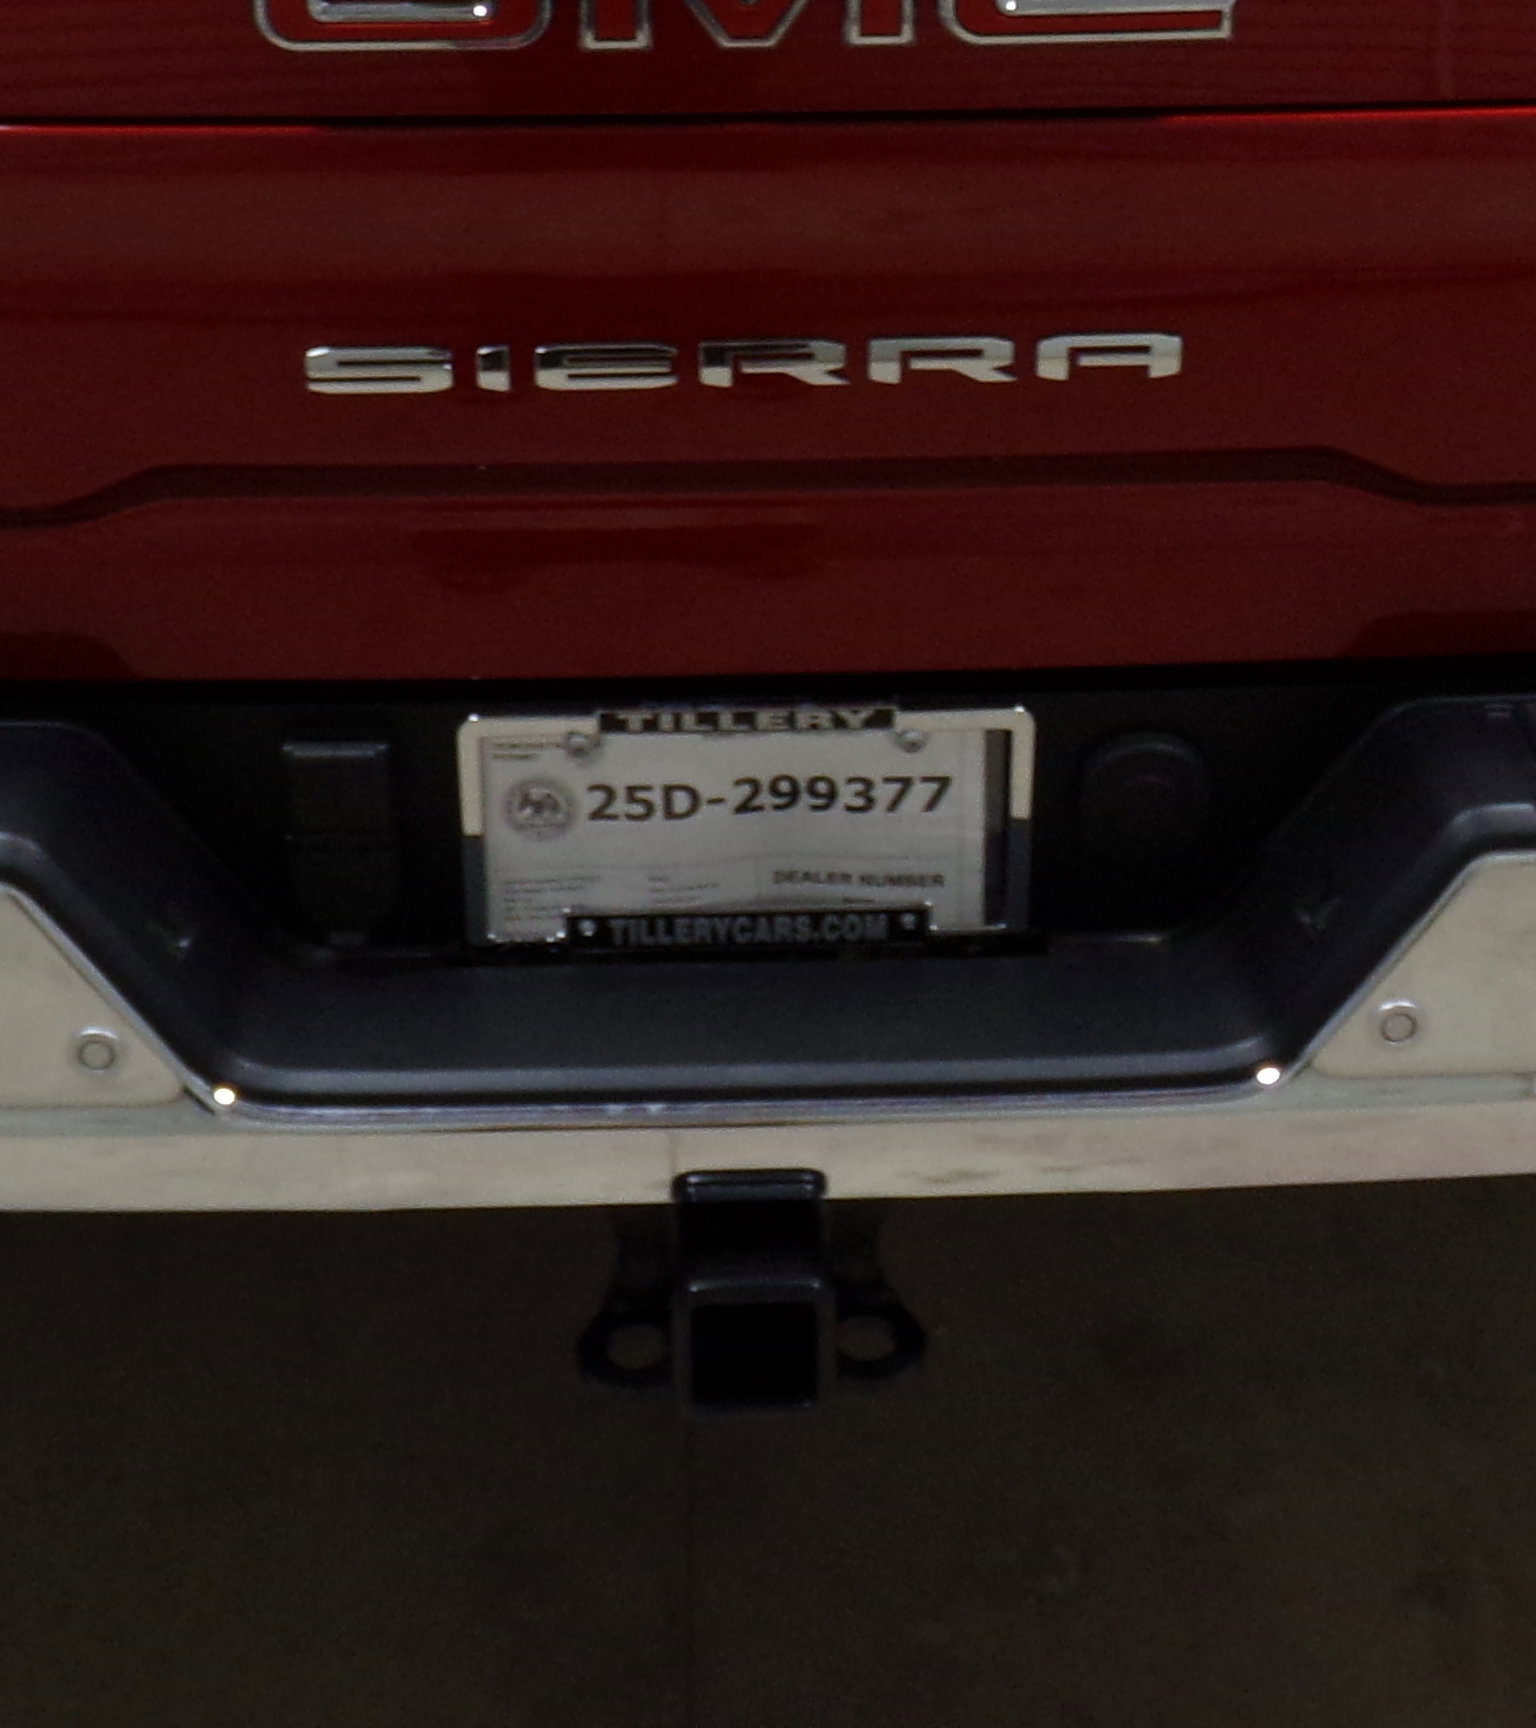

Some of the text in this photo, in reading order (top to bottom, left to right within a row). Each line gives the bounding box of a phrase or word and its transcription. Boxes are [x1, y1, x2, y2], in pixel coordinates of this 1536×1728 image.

[304, 331, 1184, 395] SIERRA
[615, 709, 875, 733] TILLERY
[585, 774, 953, 822] 25D-299377
[773, 870, 946, 888] DEALER NUMBER
[607, 912, 890, 946] TILLERYCARS.COM
